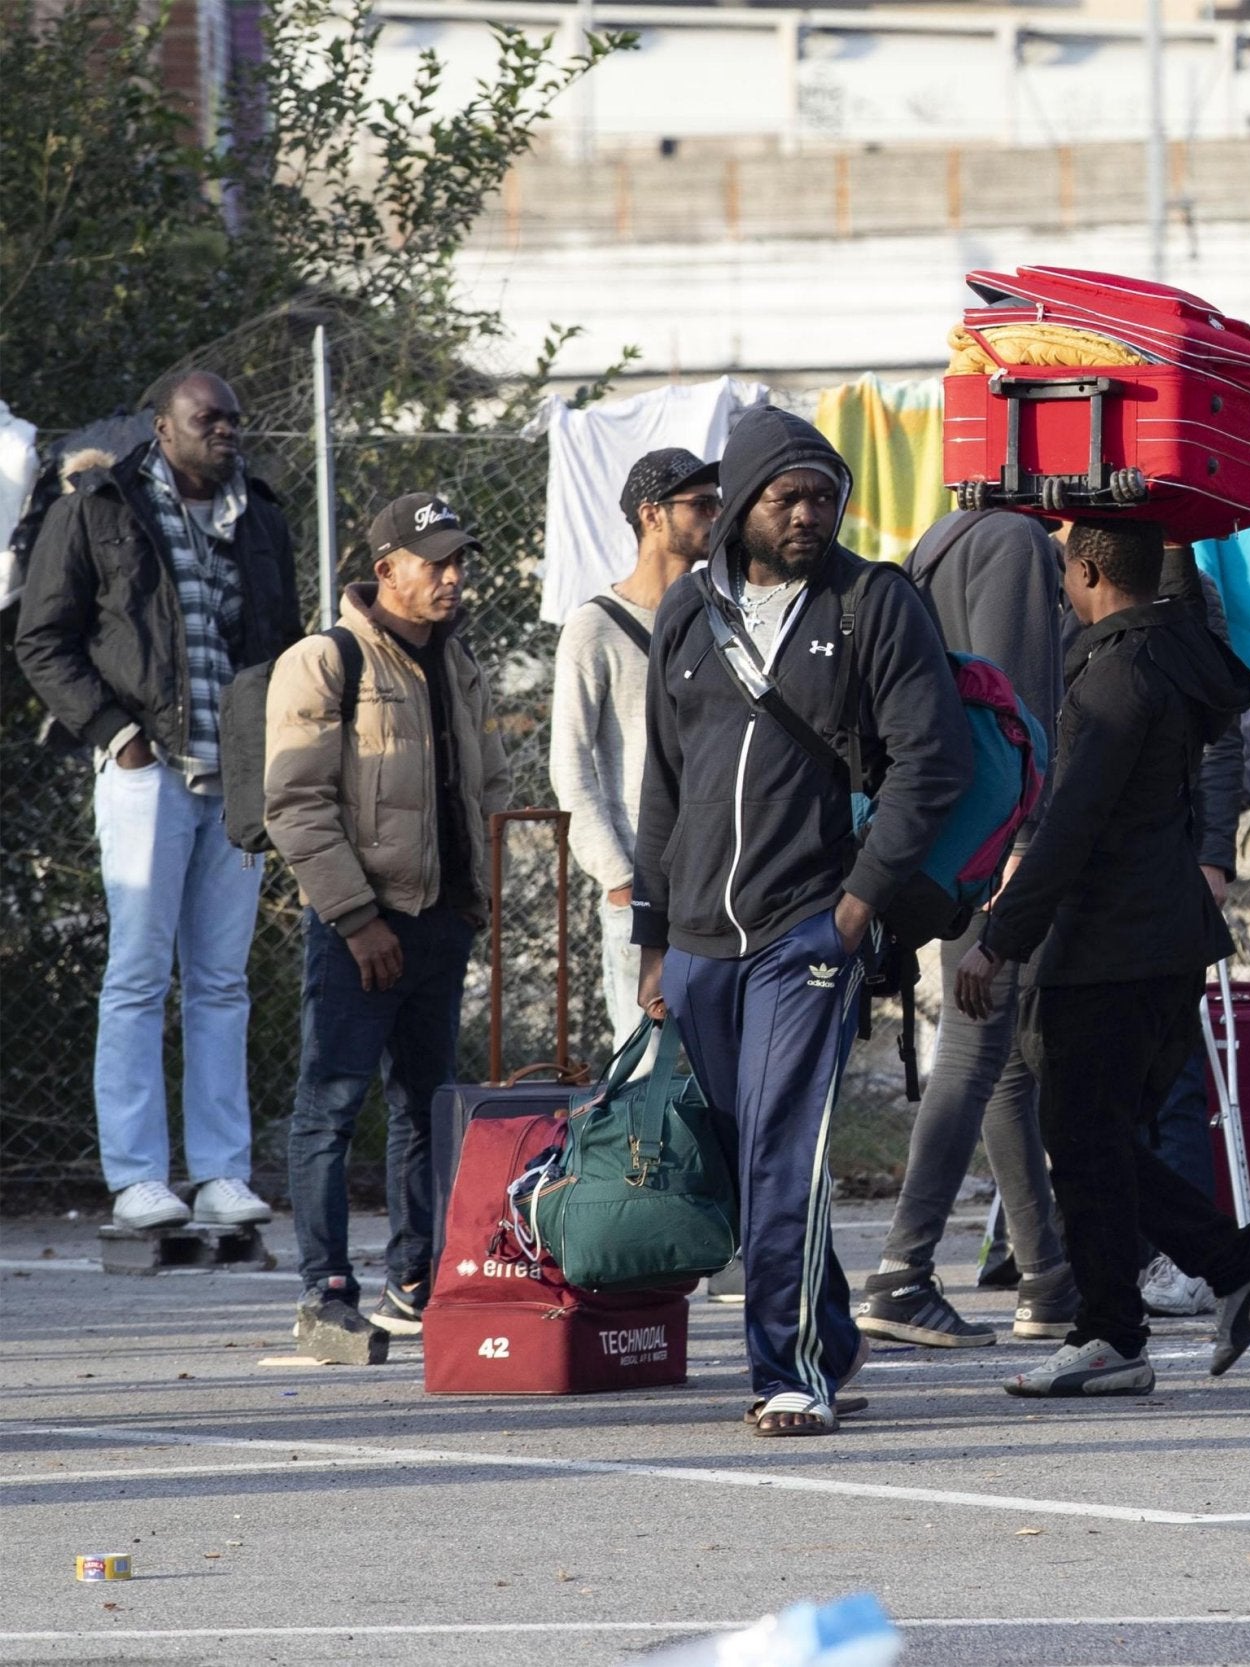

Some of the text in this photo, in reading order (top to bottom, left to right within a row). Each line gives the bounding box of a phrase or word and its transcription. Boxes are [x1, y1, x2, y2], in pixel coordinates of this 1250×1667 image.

[806, 979, 836, 989] adidas
[891, 1284, 920, 1298] adidas
[478, 1337, 510, 1358] 42
